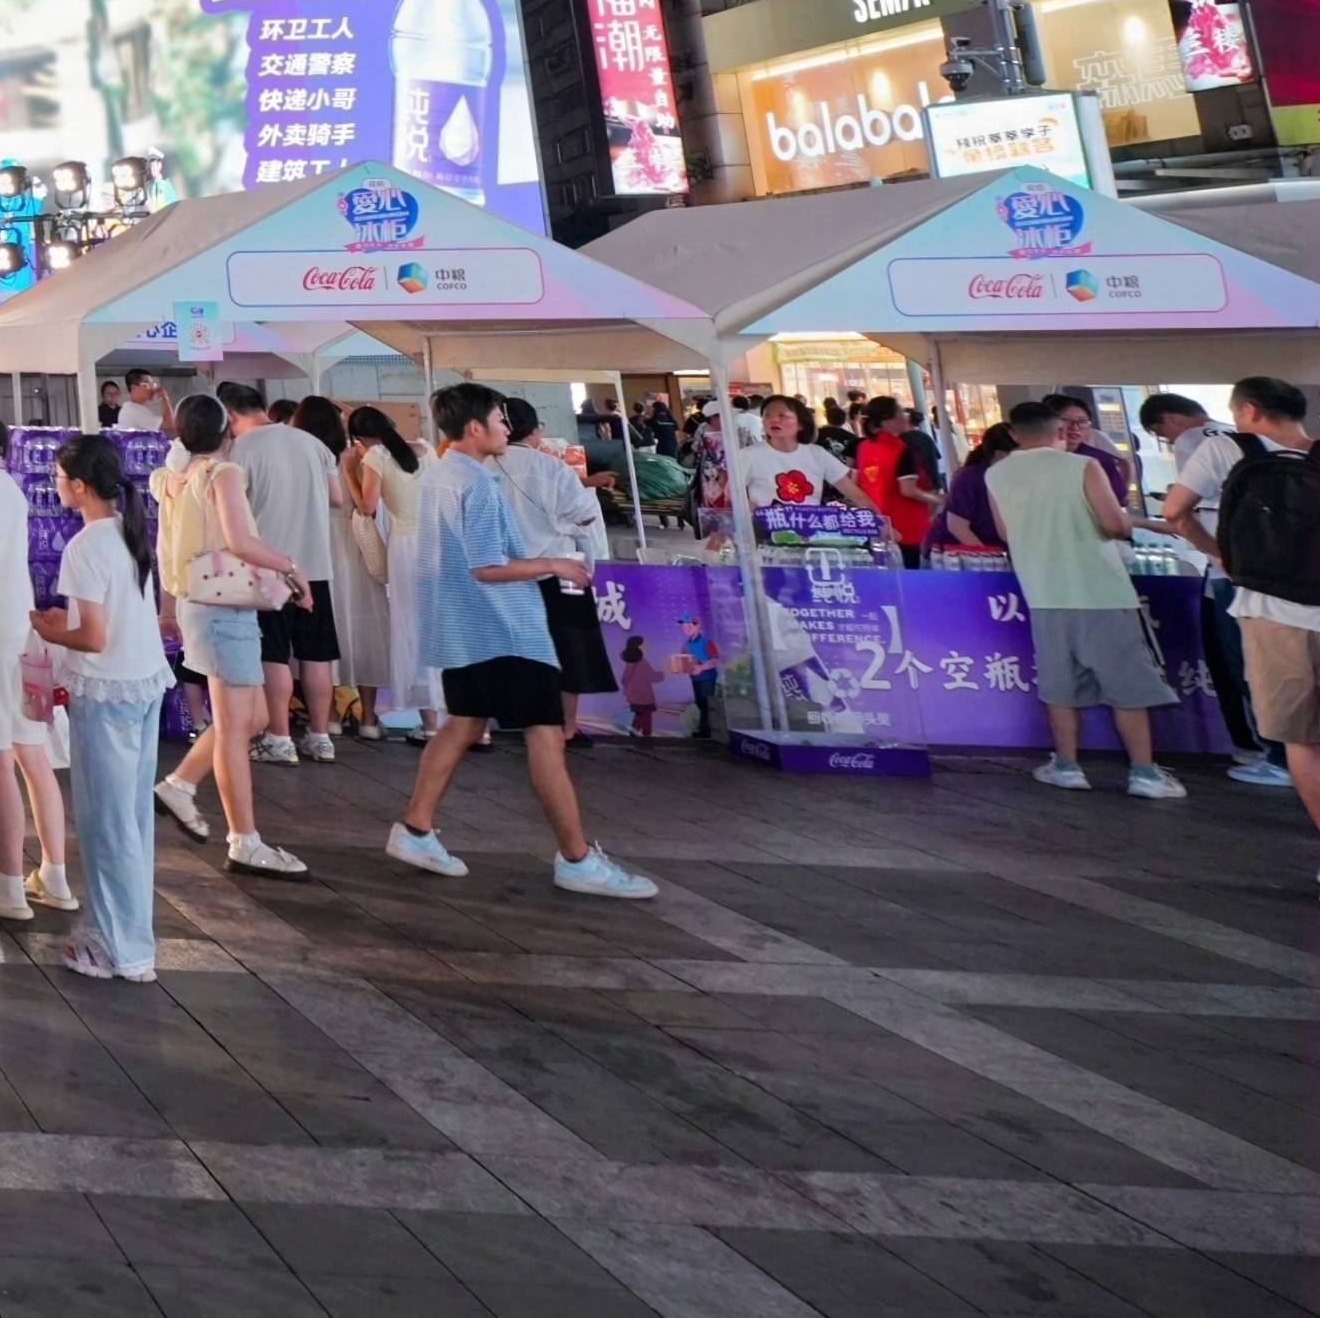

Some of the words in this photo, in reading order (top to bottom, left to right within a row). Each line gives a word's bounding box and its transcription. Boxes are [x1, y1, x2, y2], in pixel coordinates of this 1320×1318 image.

[259, 17, 354, 41] 环卫工人
[258, 53, 356, 77] 交通警察
[258, 88, 357, 112] 快递小哥
[767, 82, 957, 161] balaba
[257, 123, 356, 147] 外卖骑手
[255, 158, 349, 184] 建筑工
[435, 268, 466, 282] 中粮
[436, 283, 468, 291] COFCO
[1106, 275, 1141, 289] 中粮
[1108, 290, 1142, 298] COFCO
[988, 593, 1026, 622] 以
[855, 641, 1040, 692] 2个空瓶
